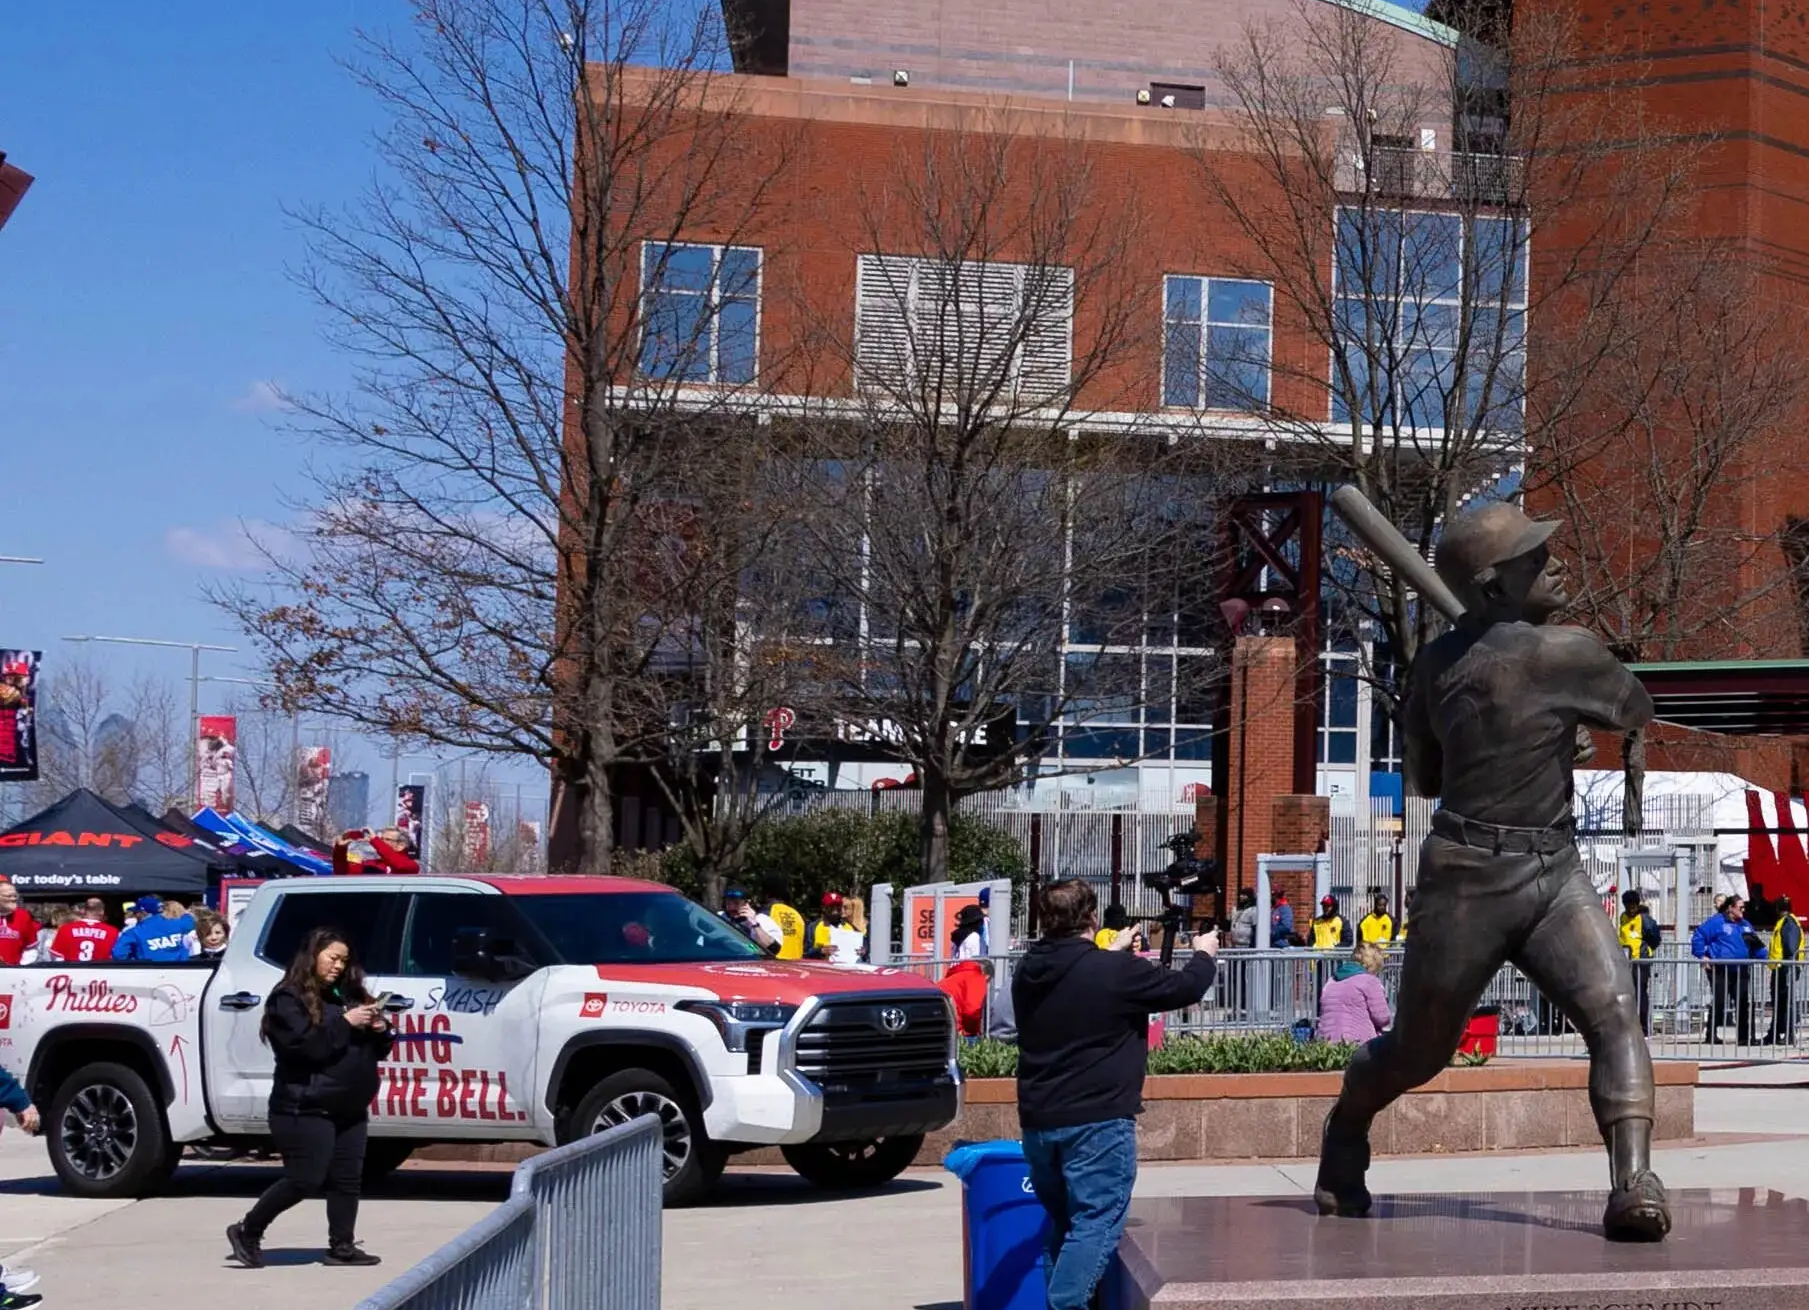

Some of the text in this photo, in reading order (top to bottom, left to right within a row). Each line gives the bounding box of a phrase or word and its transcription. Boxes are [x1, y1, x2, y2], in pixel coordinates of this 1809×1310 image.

[0, 831, 144, 848] GIANT
[10, 873, 121, 887] for today's table
[78, 940, 95, 962] 3
[45, 973, 138, 1014] Phillies
[424, 987, 507, 1016] SMASH
[612, 1000, 666, 1014] TOYOTA
[387, 1013, 453, 1064] ING
[369, 1066, 527, 1122] THE BELL.
